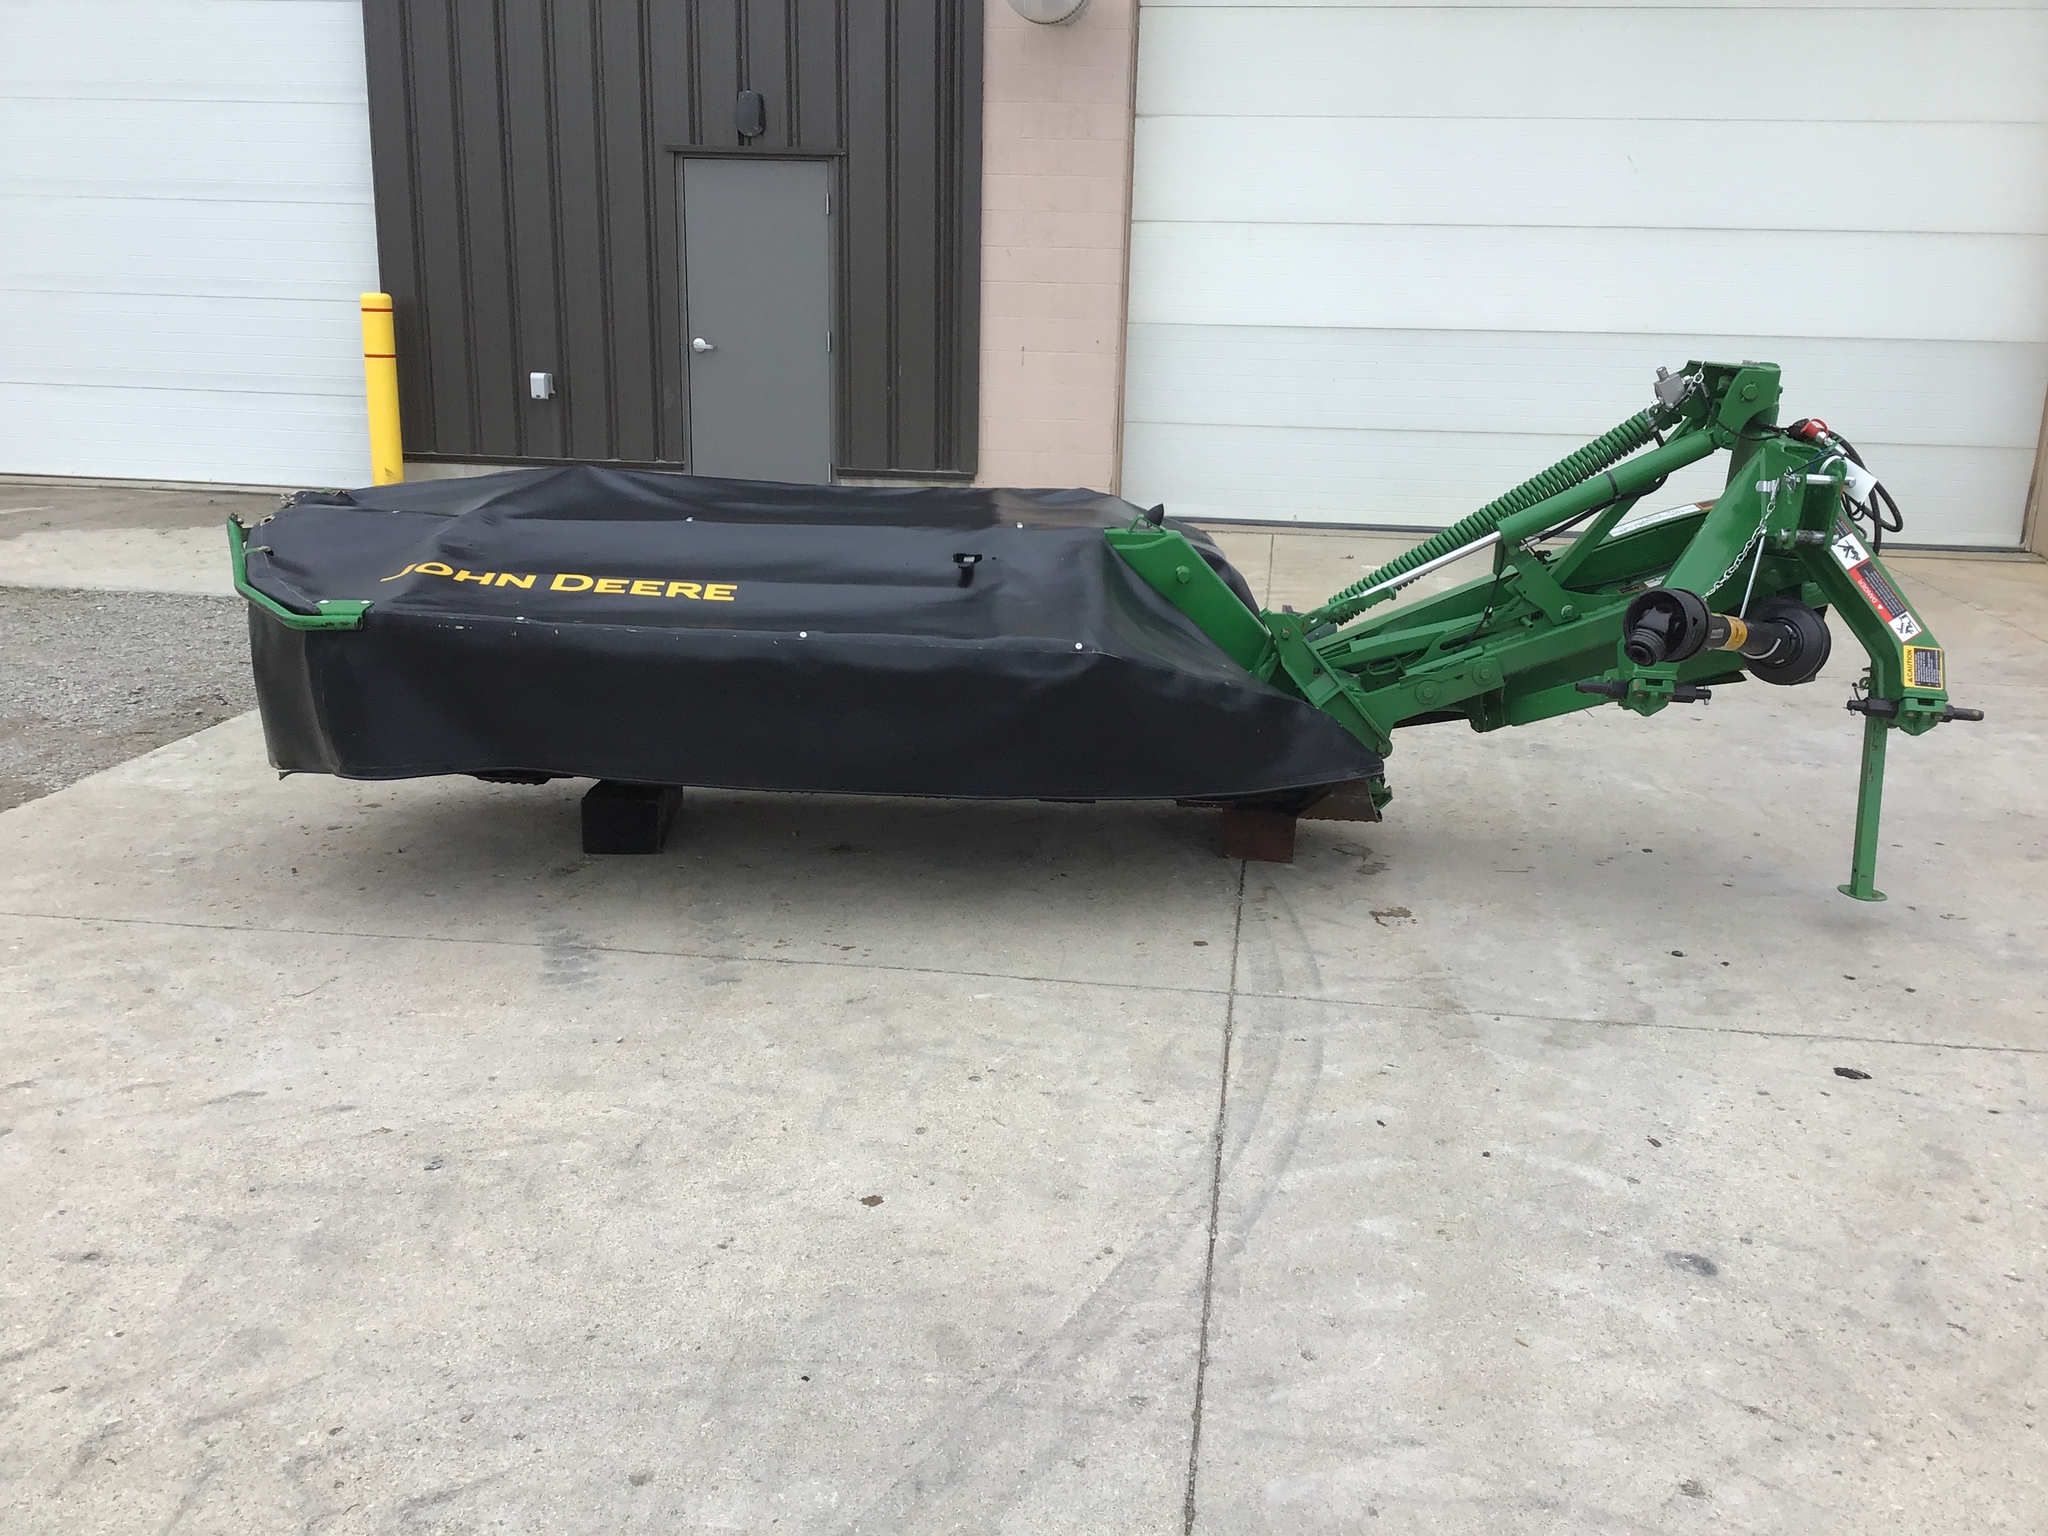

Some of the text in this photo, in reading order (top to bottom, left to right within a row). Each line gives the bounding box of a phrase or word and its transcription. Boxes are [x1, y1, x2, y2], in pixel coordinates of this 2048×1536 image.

[379, 562, 738, 601] JOHN DEERE
[1857, 578, 1879, 605] DANGER
